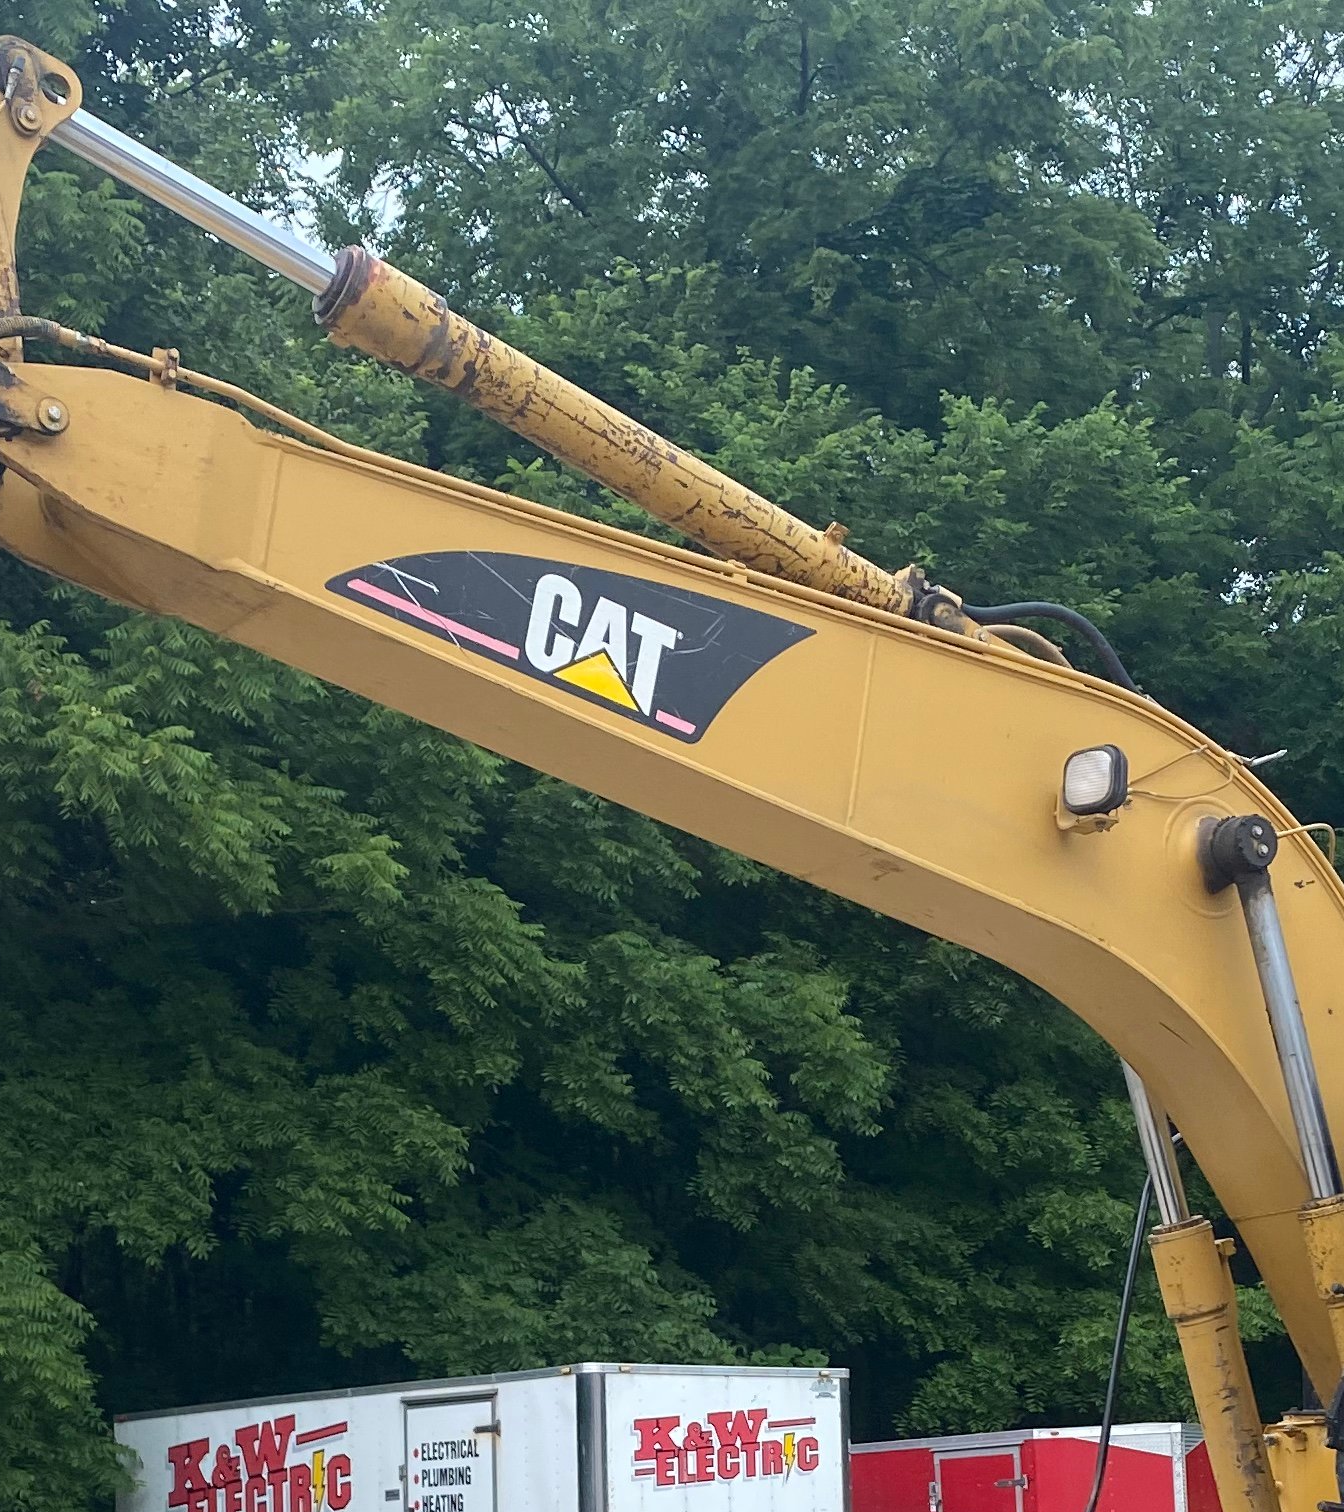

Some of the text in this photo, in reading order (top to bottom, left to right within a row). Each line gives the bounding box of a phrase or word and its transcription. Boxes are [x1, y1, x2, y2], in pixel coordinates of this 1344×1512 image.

[524, 573, 678, 716] CAT
[168, 1414, 296, 1508] K&W
[421, 1438, 480, 1462] ELECTRICAL
[634, 1407, 768, 1461] K&W
[421, 1466, 472, 1488] PLUMBING
